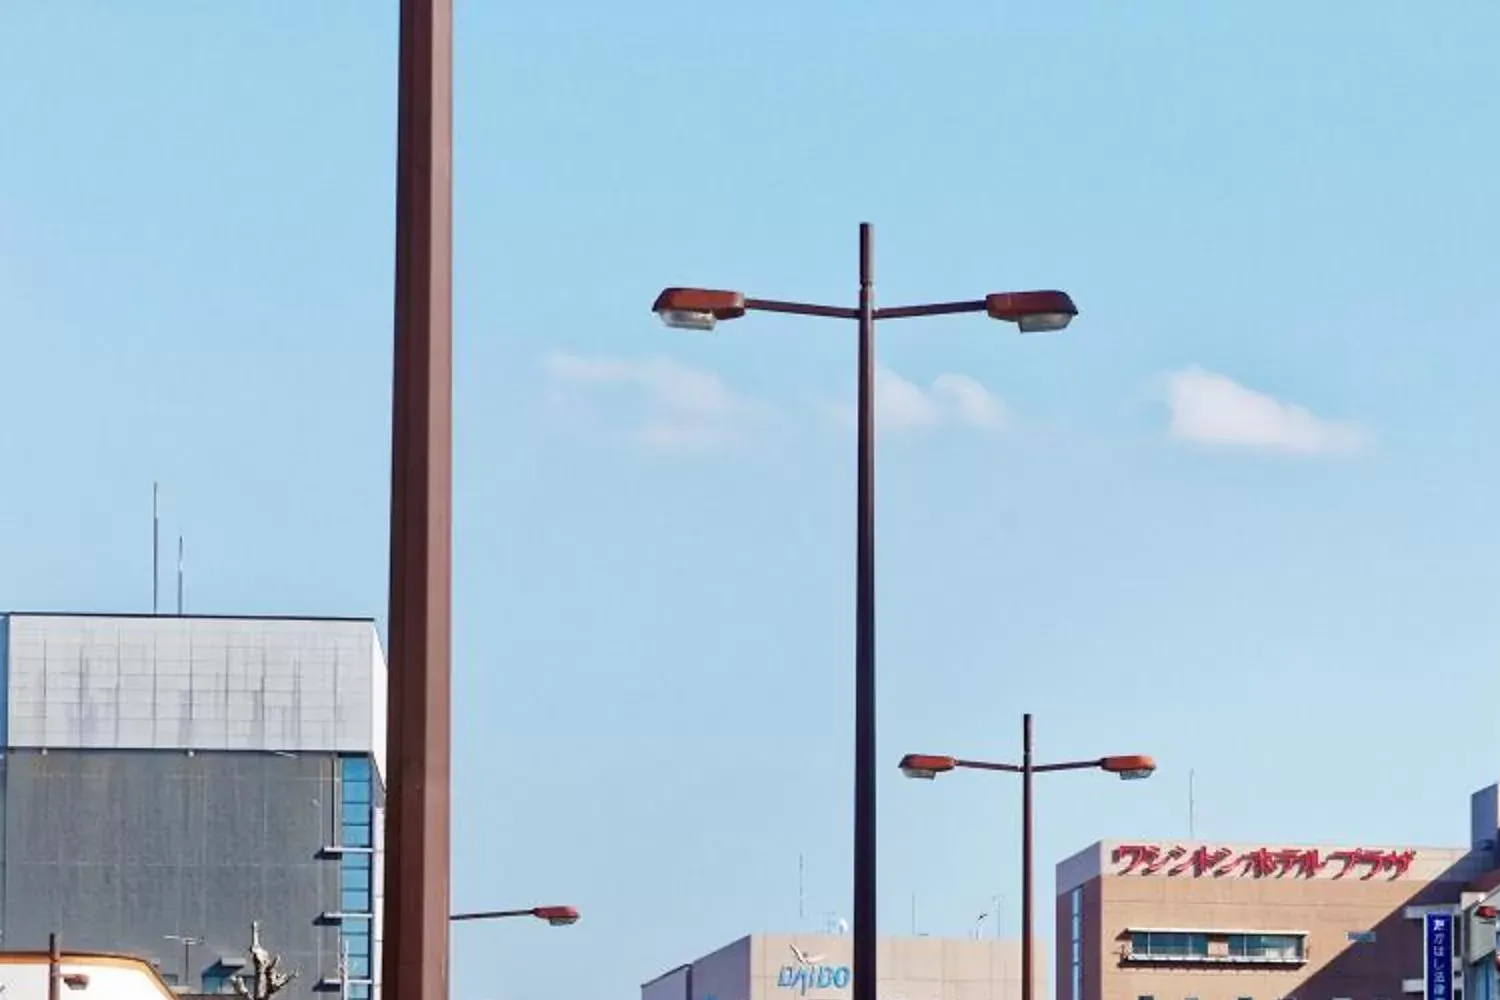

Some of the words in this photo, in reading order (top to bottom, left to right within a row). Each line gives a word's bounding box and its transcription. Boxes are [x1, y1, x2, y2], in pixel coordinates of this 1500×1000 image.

[1111, 846, 1416, 881] ワシントンホテルプラザ
[777, 965, 851, 995] DAIDO
